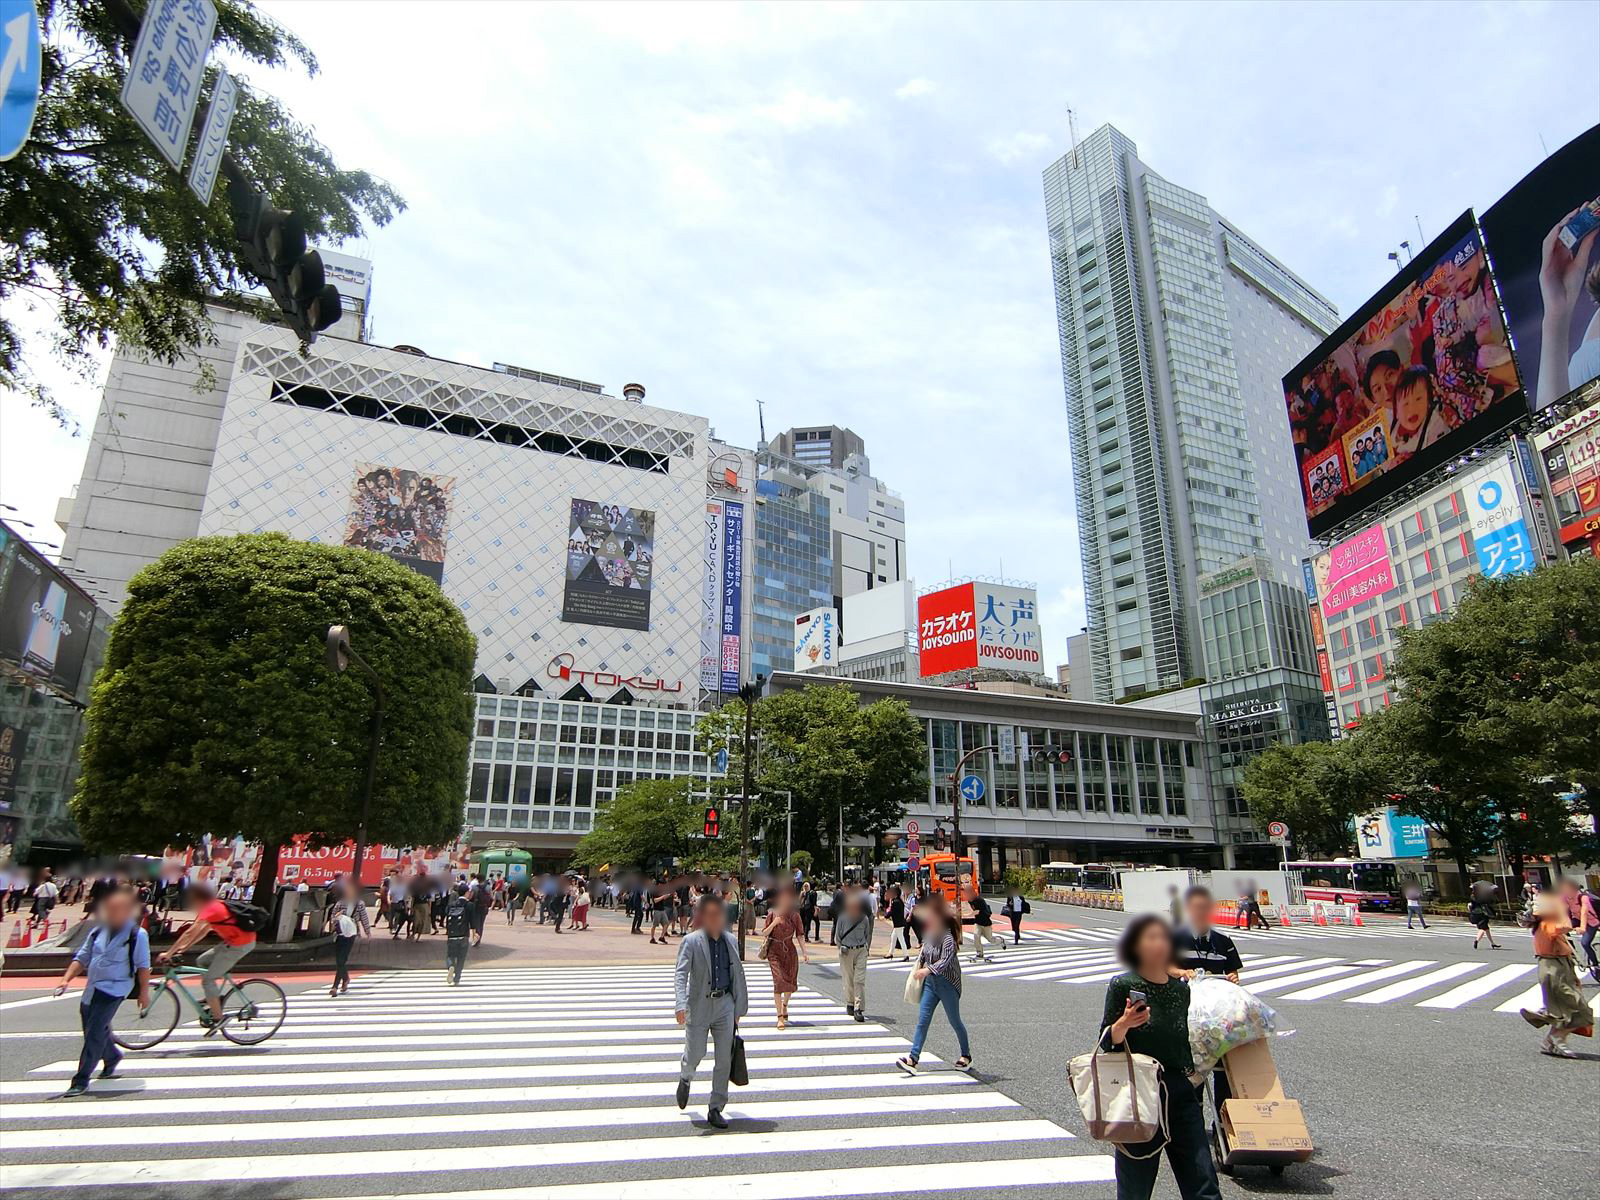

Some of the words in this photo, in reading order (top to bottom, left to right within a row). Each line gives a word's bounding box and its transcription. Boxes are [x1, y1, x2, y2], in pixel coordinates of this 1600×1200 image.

[152, 0, 179, 52] hibuya
[1548, 453, 1565, 471] 9F
[1476, 505, 1513, 529] eyecity
[1346, 546, 1378, 569] クリニック
[1332, 571, 1388, 608] 品川美容外科
[978, 594, 1035, 627] 大声
[921, 610, 973, 638] カラオケ
[921, 628, 974, 651] JOYSOUND
[980, 625, 1036, 647] だそうぜ
[979, 644, 1039, 662] JOYSOUND
[571, 670, 682, 692] TOKYU
[1210, 708, 1245, 721] MARK
[1251, 701, 1281, 713] CITY
[1225, 699, 1260, 710] SHIBUYA
